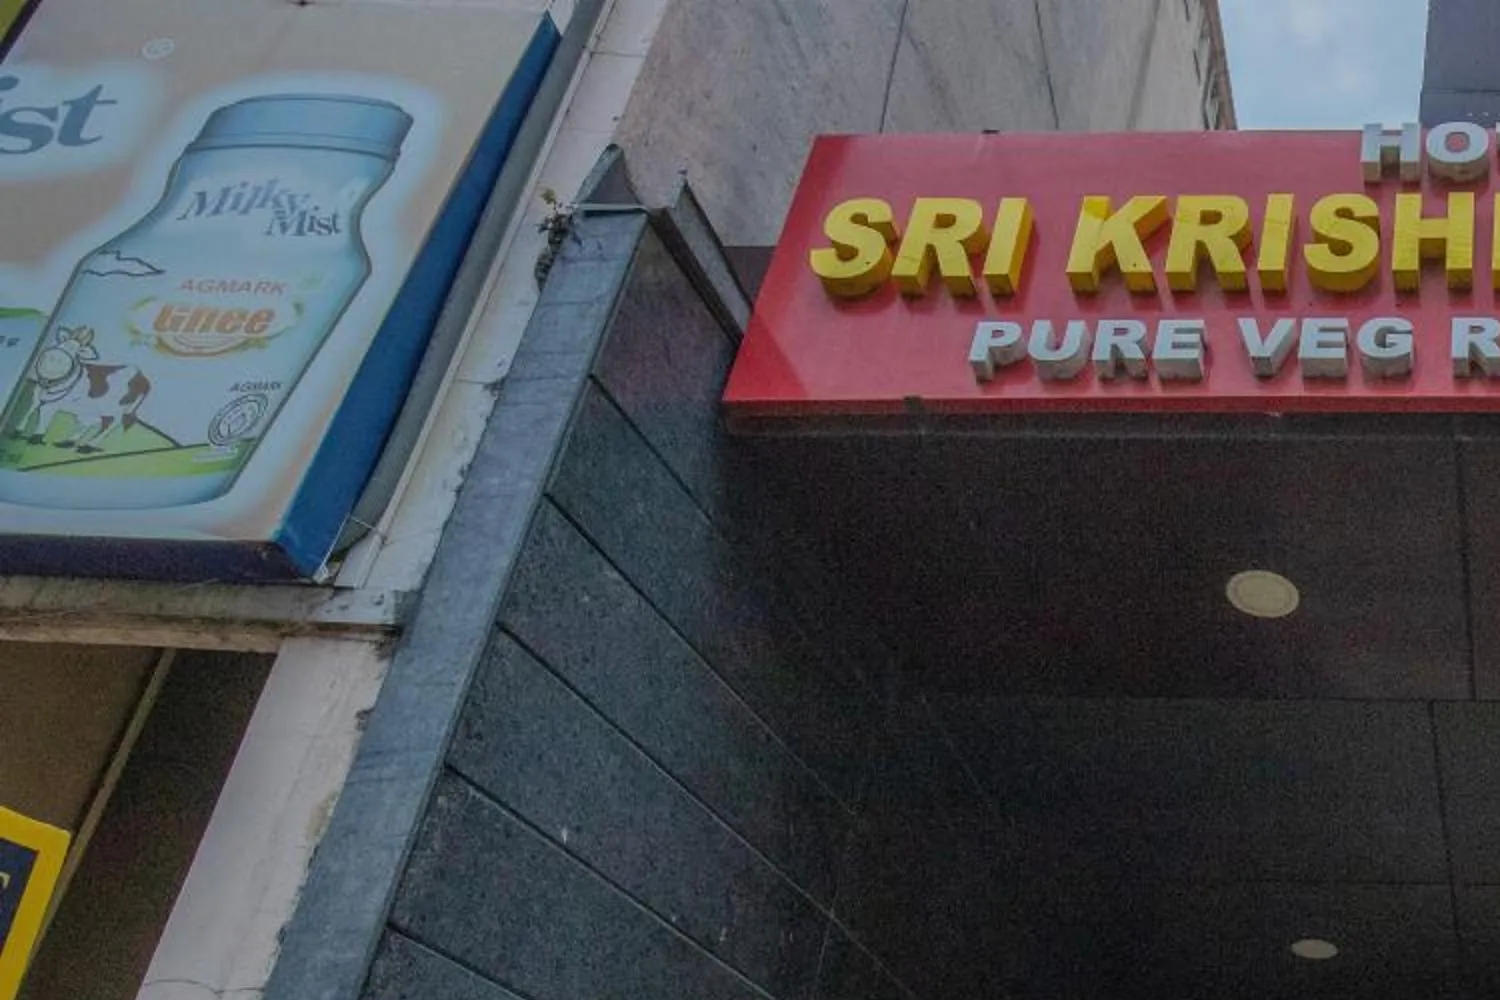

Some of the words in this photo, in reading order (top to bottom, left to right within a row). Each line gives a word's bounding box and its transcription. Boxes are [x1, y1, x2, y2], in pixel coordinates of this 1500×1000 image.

[176, 177, 312, 220] Milky
[264, 204, 342, 237] Mist
[810, 196, 1036, 298] SRI
[176, 278, 289, 297] AGMARK
[969, 319, 1204, 382] PURE
[1237, 316, 1413, 379] VEG
